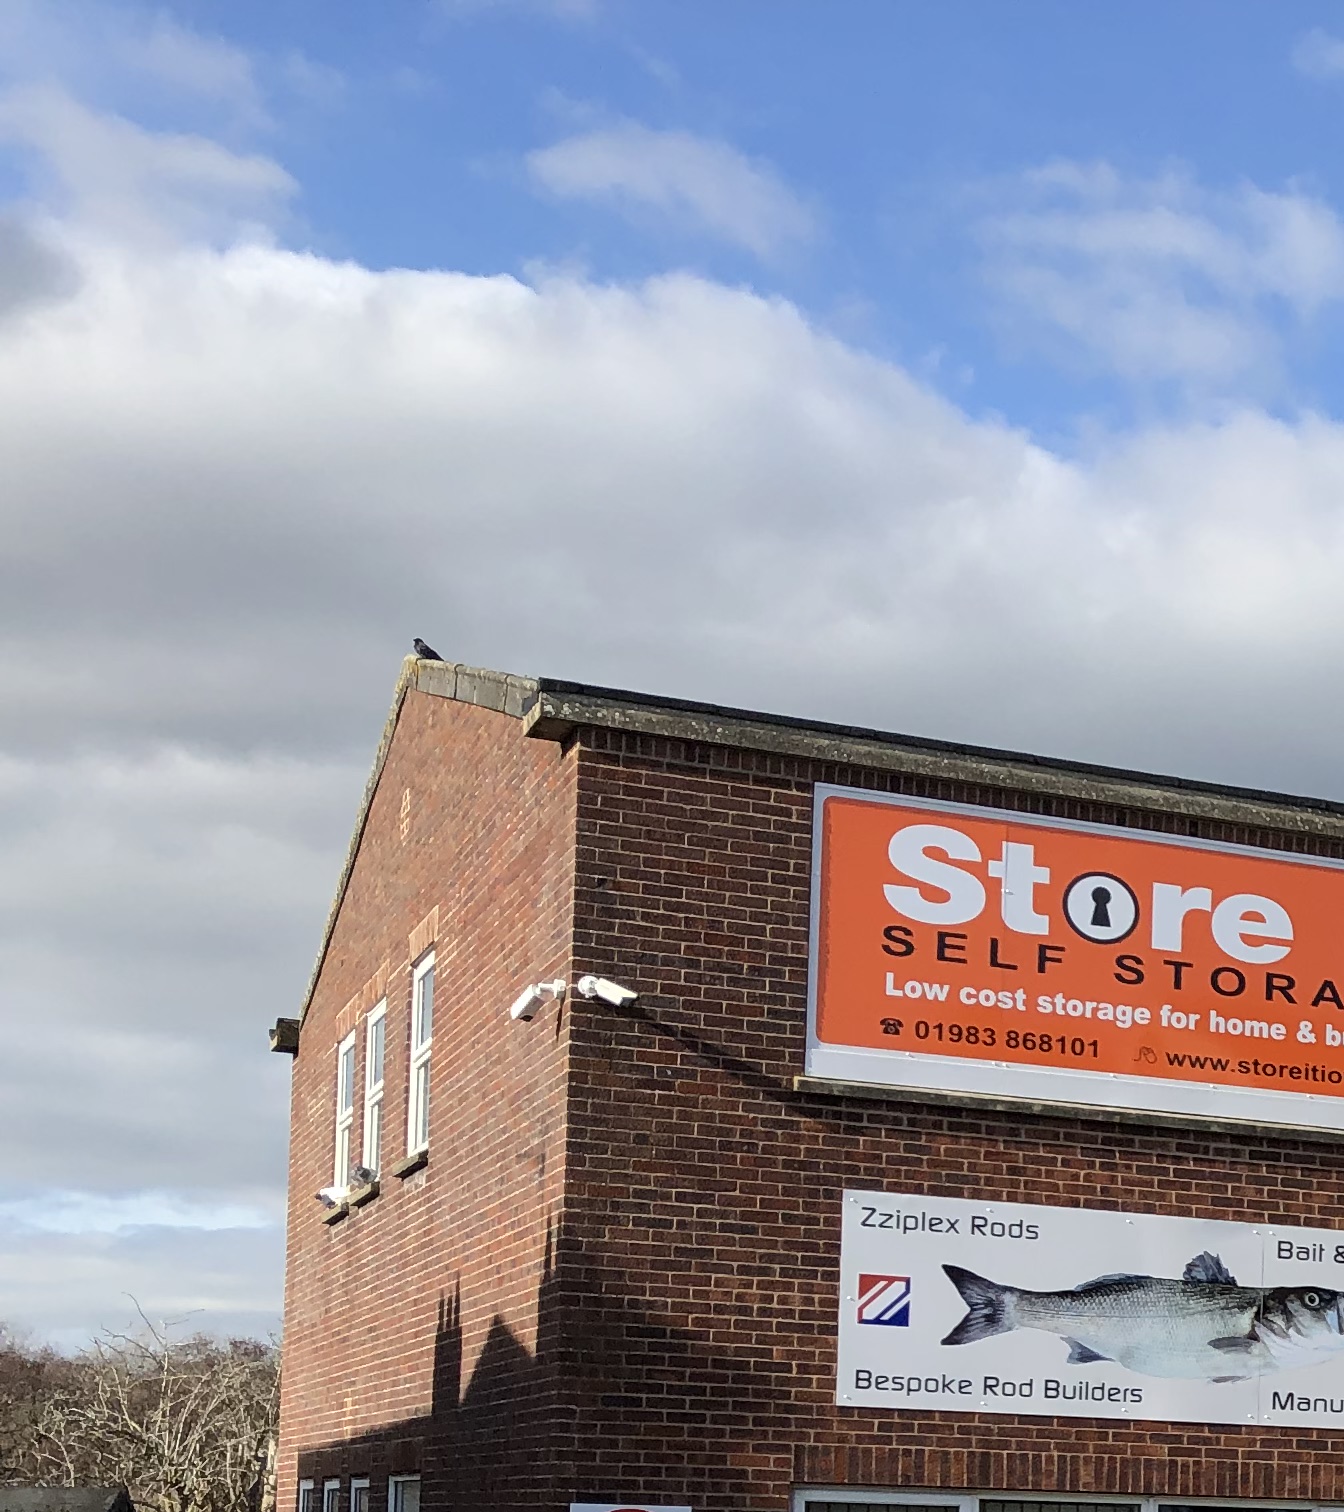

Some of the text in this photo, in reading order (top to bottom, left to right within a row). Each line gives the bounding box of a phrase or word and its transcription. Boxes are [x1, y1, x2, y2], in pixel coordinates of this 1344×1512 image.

[883, 824, 1293, 965] Store
[882, 926, 1066, 974] SELF
[886, 971, 950, 1002] Low
[960, 982, 1026, 1010] cost
[1037, 991, 1151, 1029] storage
[1161, 1003, 1200, 1031] for
[1209, 1010, 1286, 1042] home
[1296, 1021, 1316, 1043] &
[914, 1020, 997, 1047] 01983
[1005, 1028, 1100, 1058] 868101
[860, 1207, 1040, 1241] Zziplex Rods
[1277, 1240, 1325, 1264] Bait
[855, 1370, 1143, 1404] Bespoke Rod Builders
